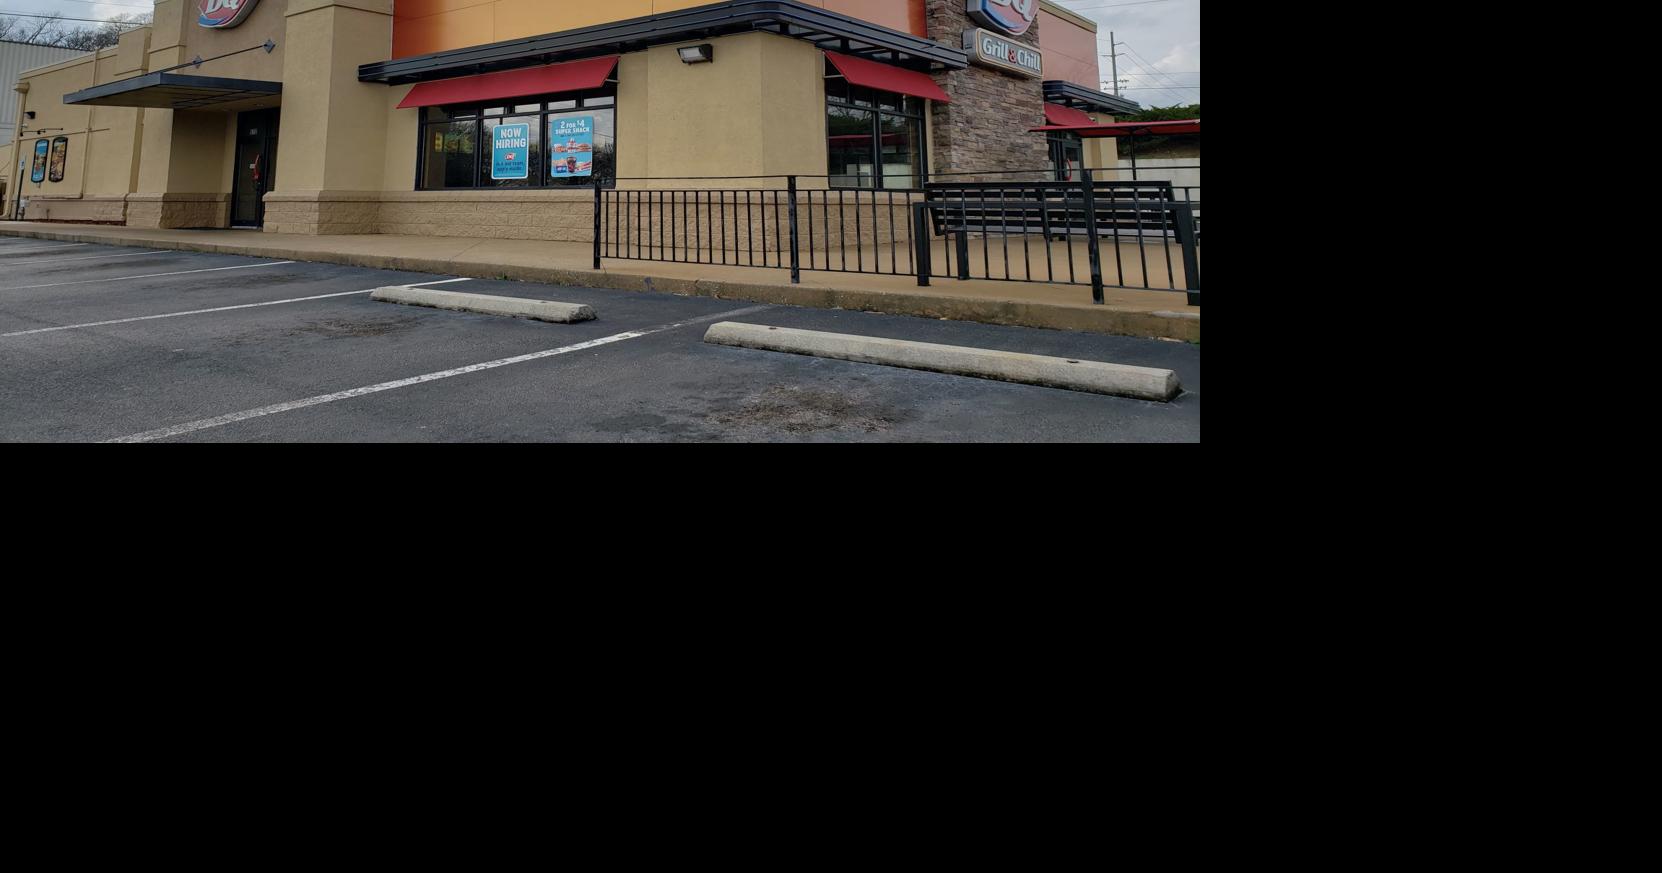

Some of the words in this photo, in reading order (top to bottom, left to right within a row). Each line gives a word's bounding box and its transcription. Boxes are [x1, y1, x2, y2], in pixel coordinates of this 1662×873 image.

[983, 38, 1008, 60] Grill
[1008, 48, 1017, 64] &
[1017, 49, 1040, 71] Chill
[560, 121, 566, 129] 2
[577, 119, 585, 127] $4
[500, 128, 522, 138] NOW
[496, 138, 526, 149] HIRING
